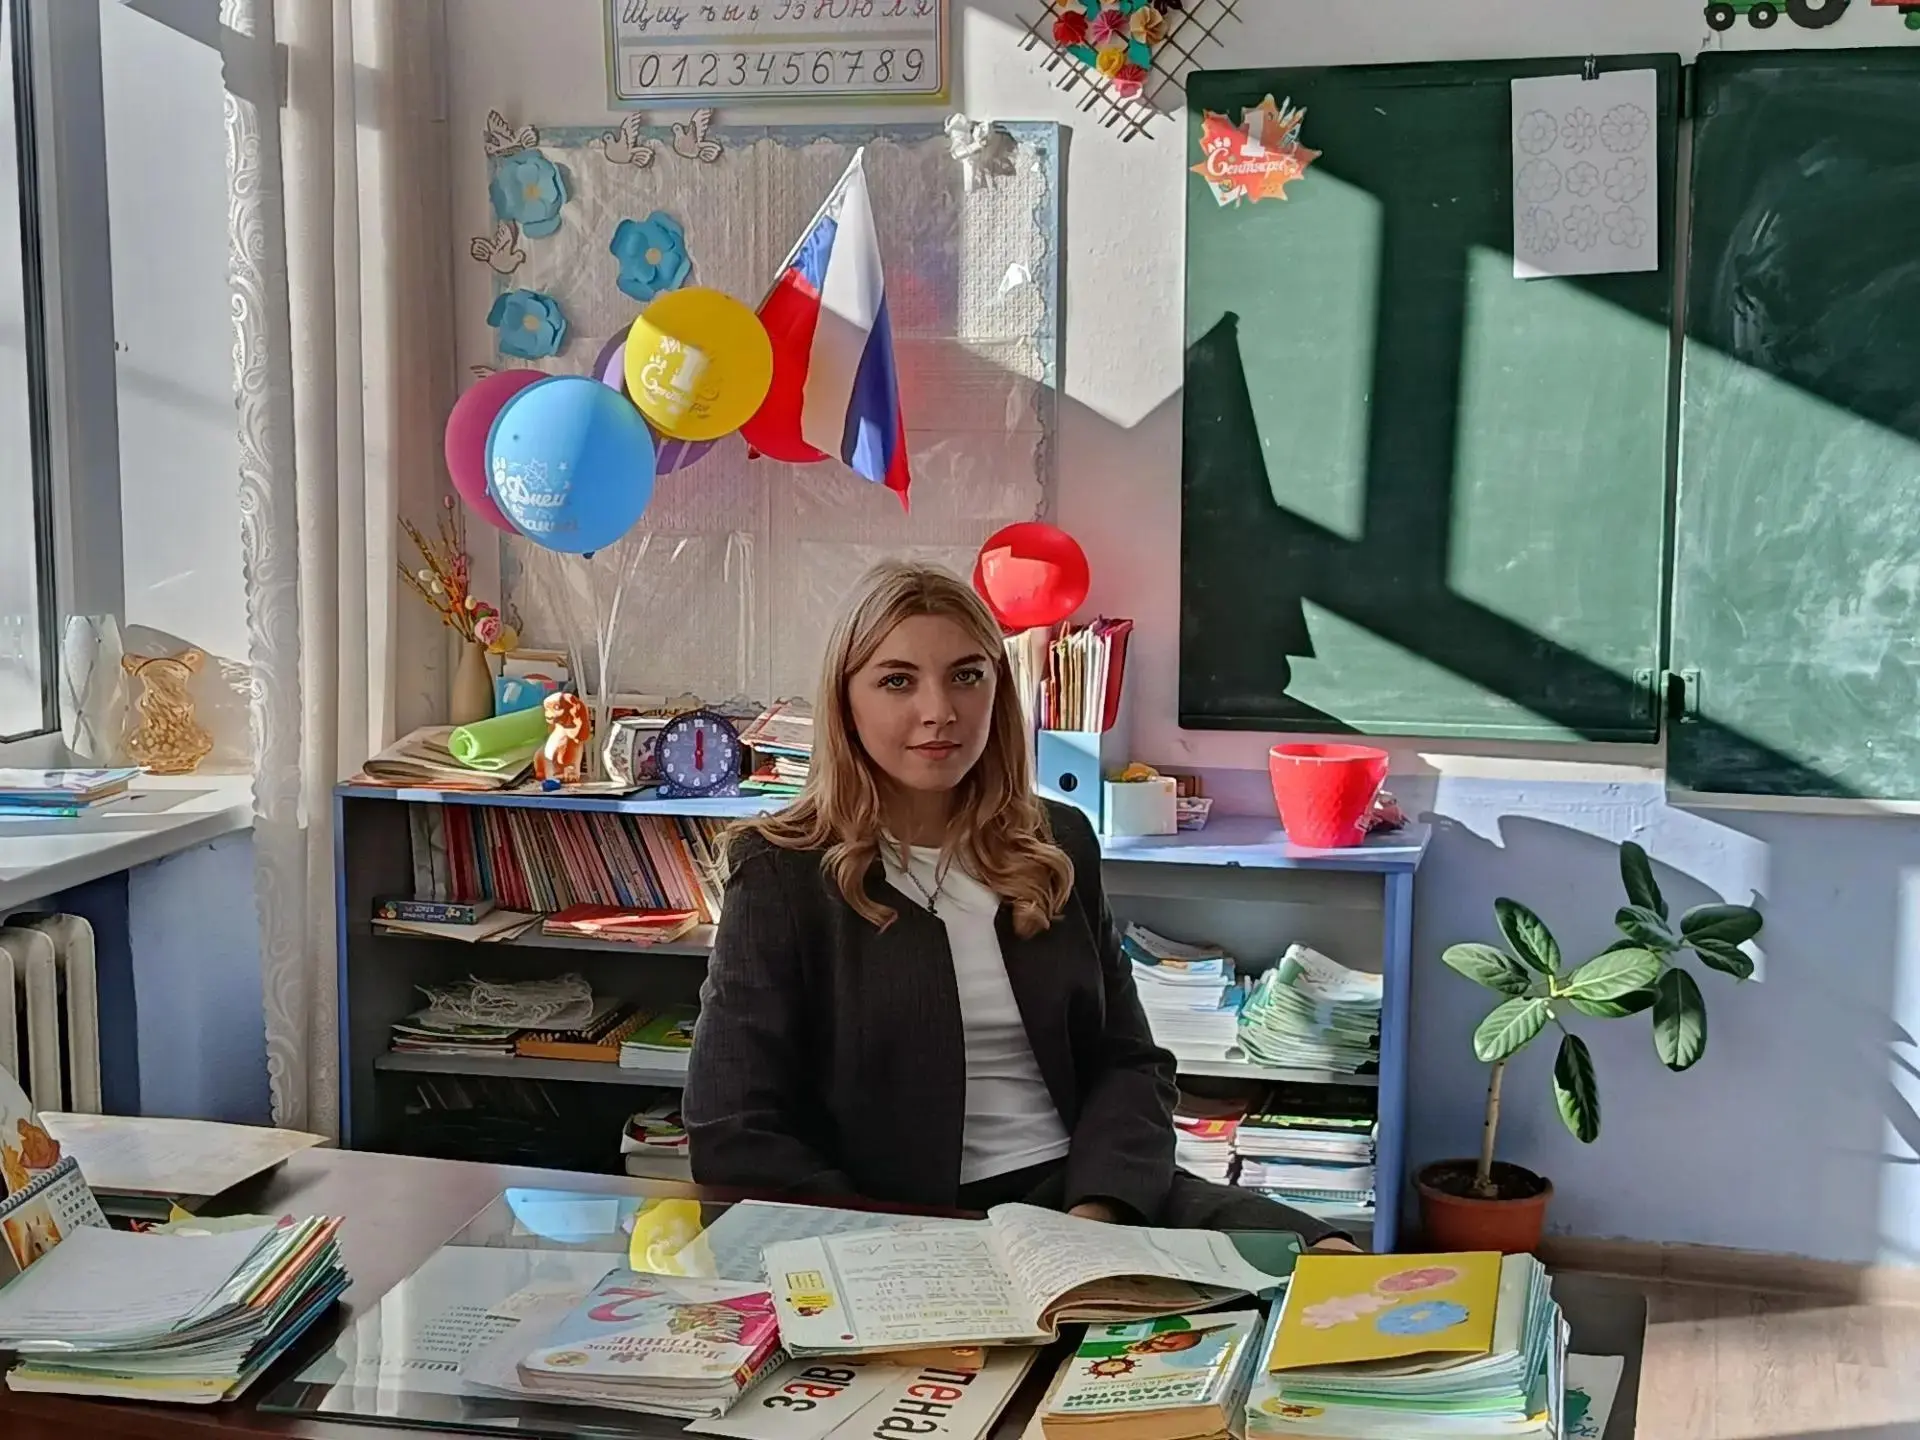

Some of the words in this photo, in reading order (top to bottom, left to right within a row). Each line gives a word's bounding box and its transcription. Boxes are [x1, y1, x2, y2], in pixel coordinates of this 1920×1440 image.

[1240, 109, 1266, 157] 1
[678, 723, 688, 732] 11
[694, 719, 705, 728] 12
[712, 723, 718, 733] 1
[666, 733, 679, 742] 10
[721, 734, 729, 743] 2
[663, 748, 671, 758] 9
[724, 748, 732, 758] 3
[666, 763, 674, 773] 8
[720, 760, 728, 772] 4
[678, 774, 686, 783] 7
[693, 777, 700, 787] 6
[710, 773, 717, 782] 5
[1067, 1381, 1208, 1402] АЗРАБОТКИ
